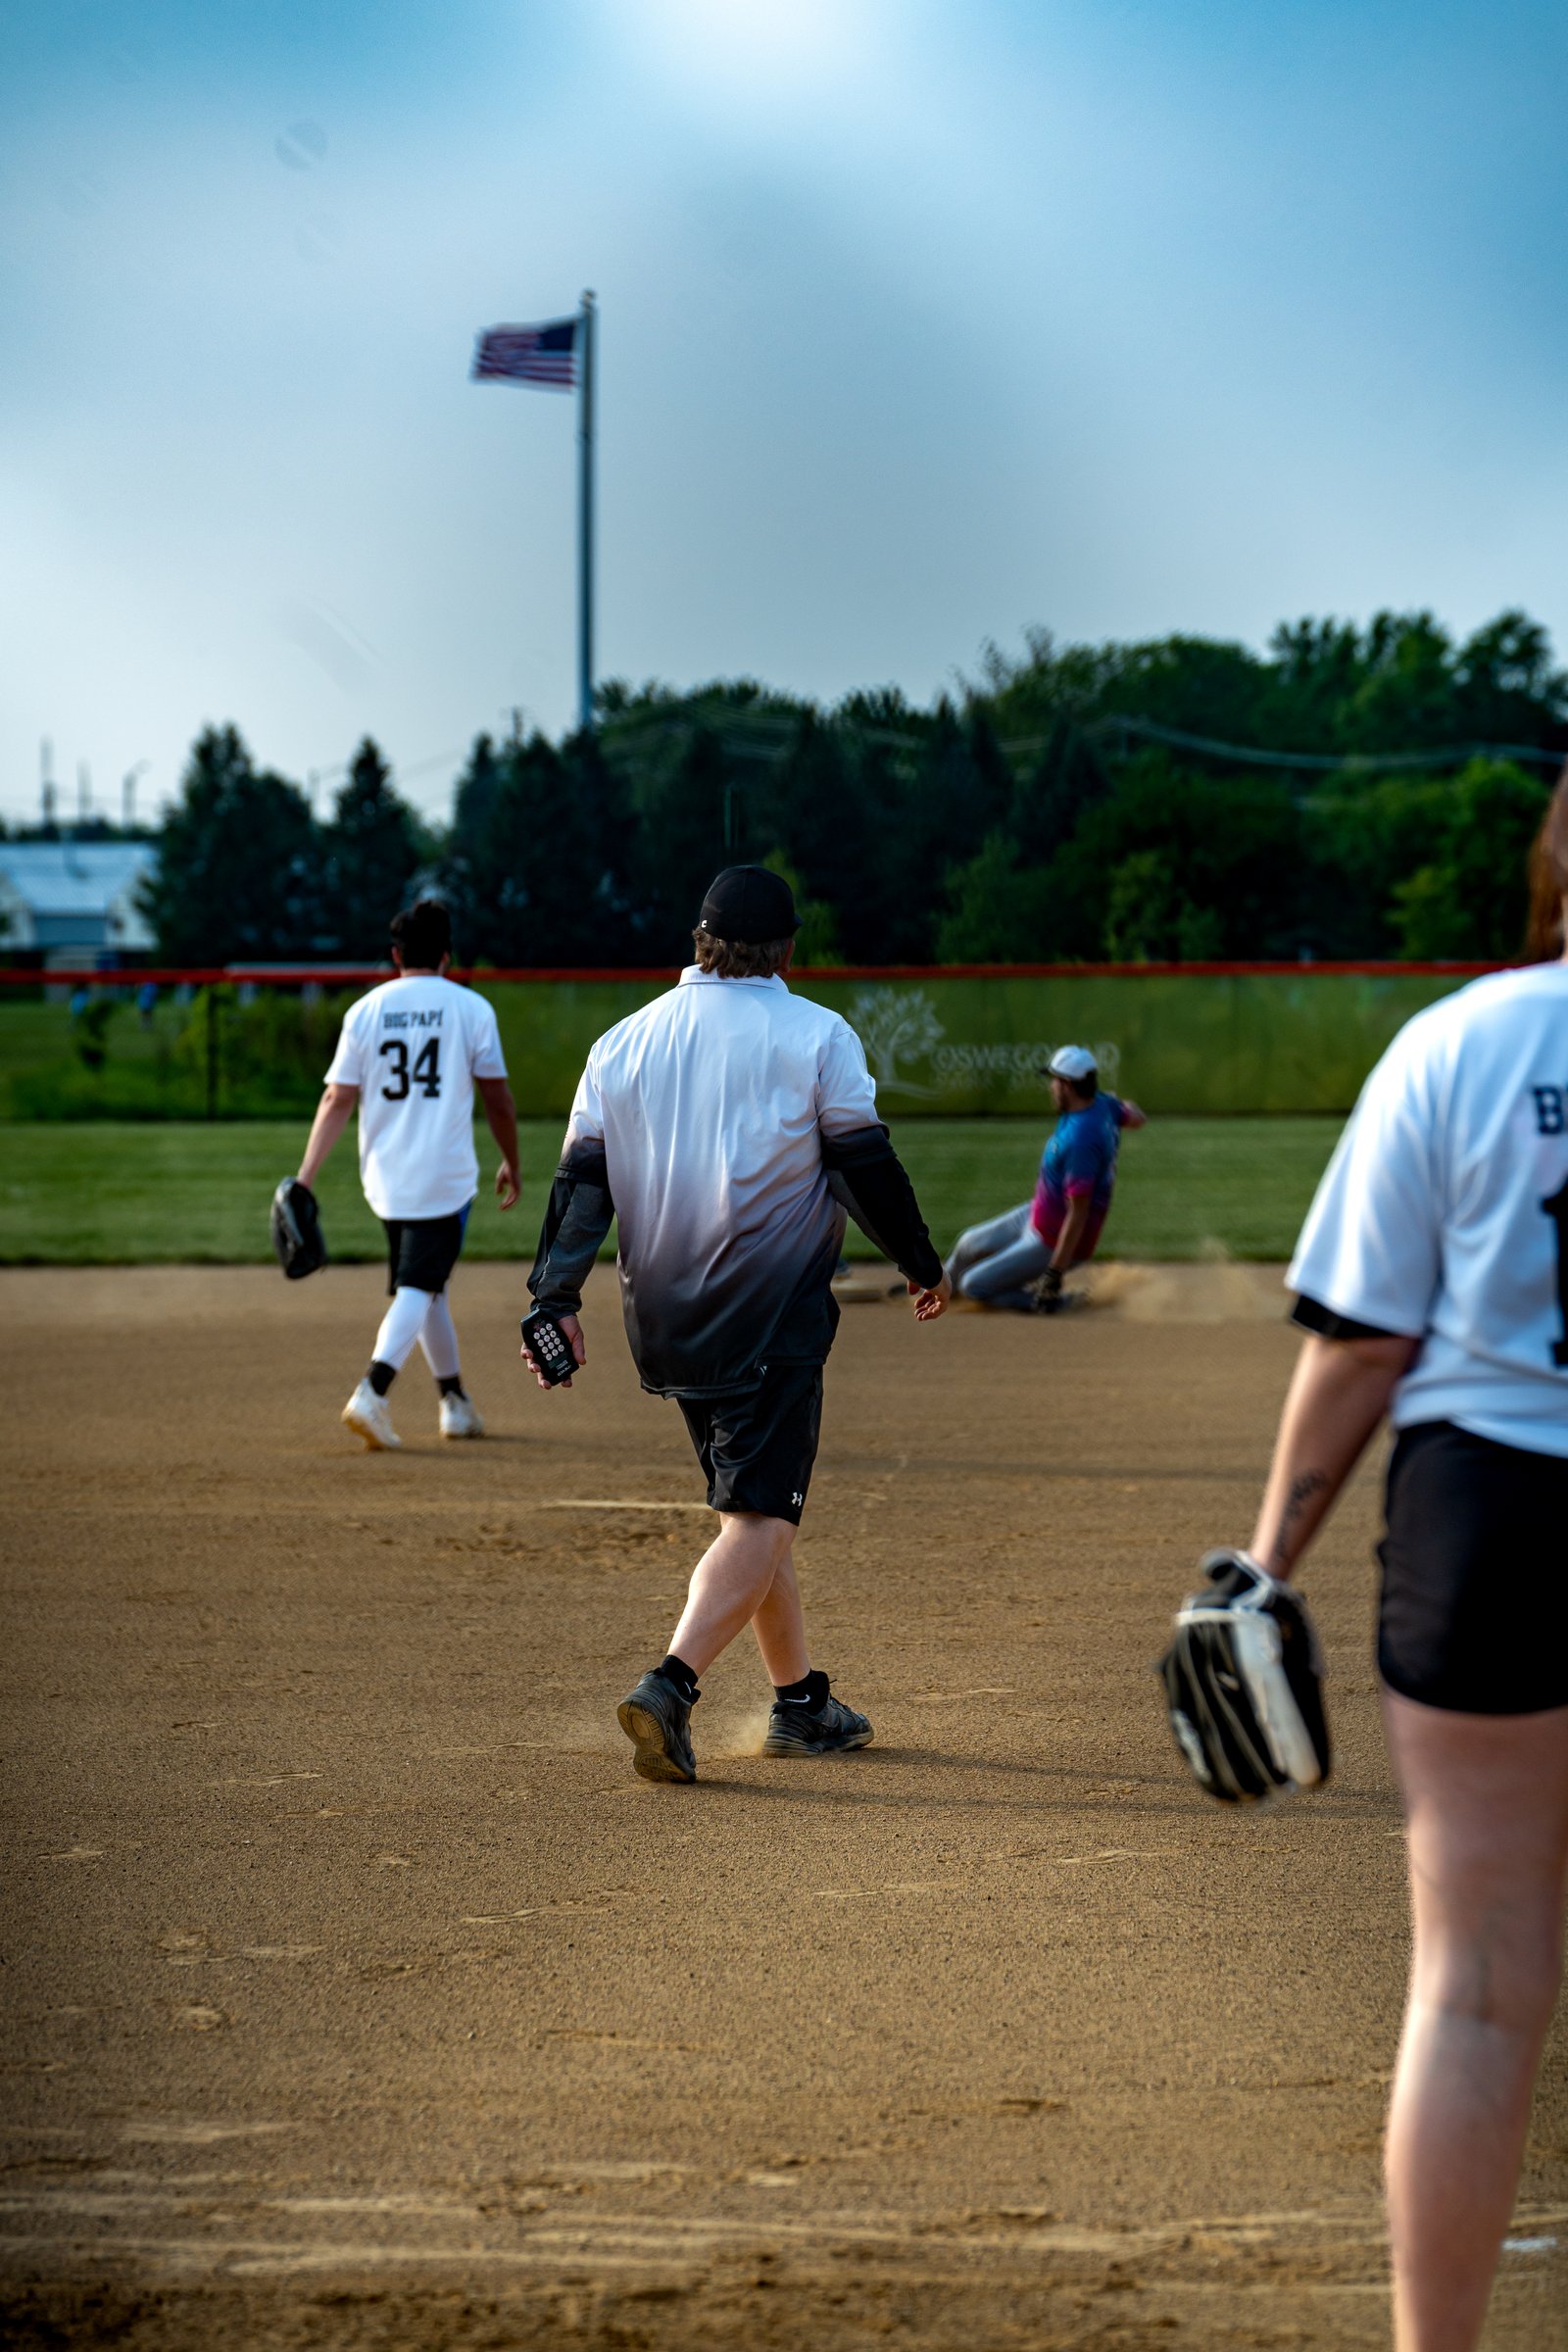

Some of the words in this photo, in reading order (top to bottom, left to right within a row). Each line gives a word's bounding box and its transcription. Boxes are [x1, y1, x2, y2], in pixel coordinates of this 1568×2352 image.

[383, 1011, 408, 1029] BIG
[411, 1007, 444, 1028] PAPI
[379, 1037, 441, 1101] 34
[933, 1042, 1120, 1071] OSWEGOD
[1533, 1085, 1568, 1135] B
